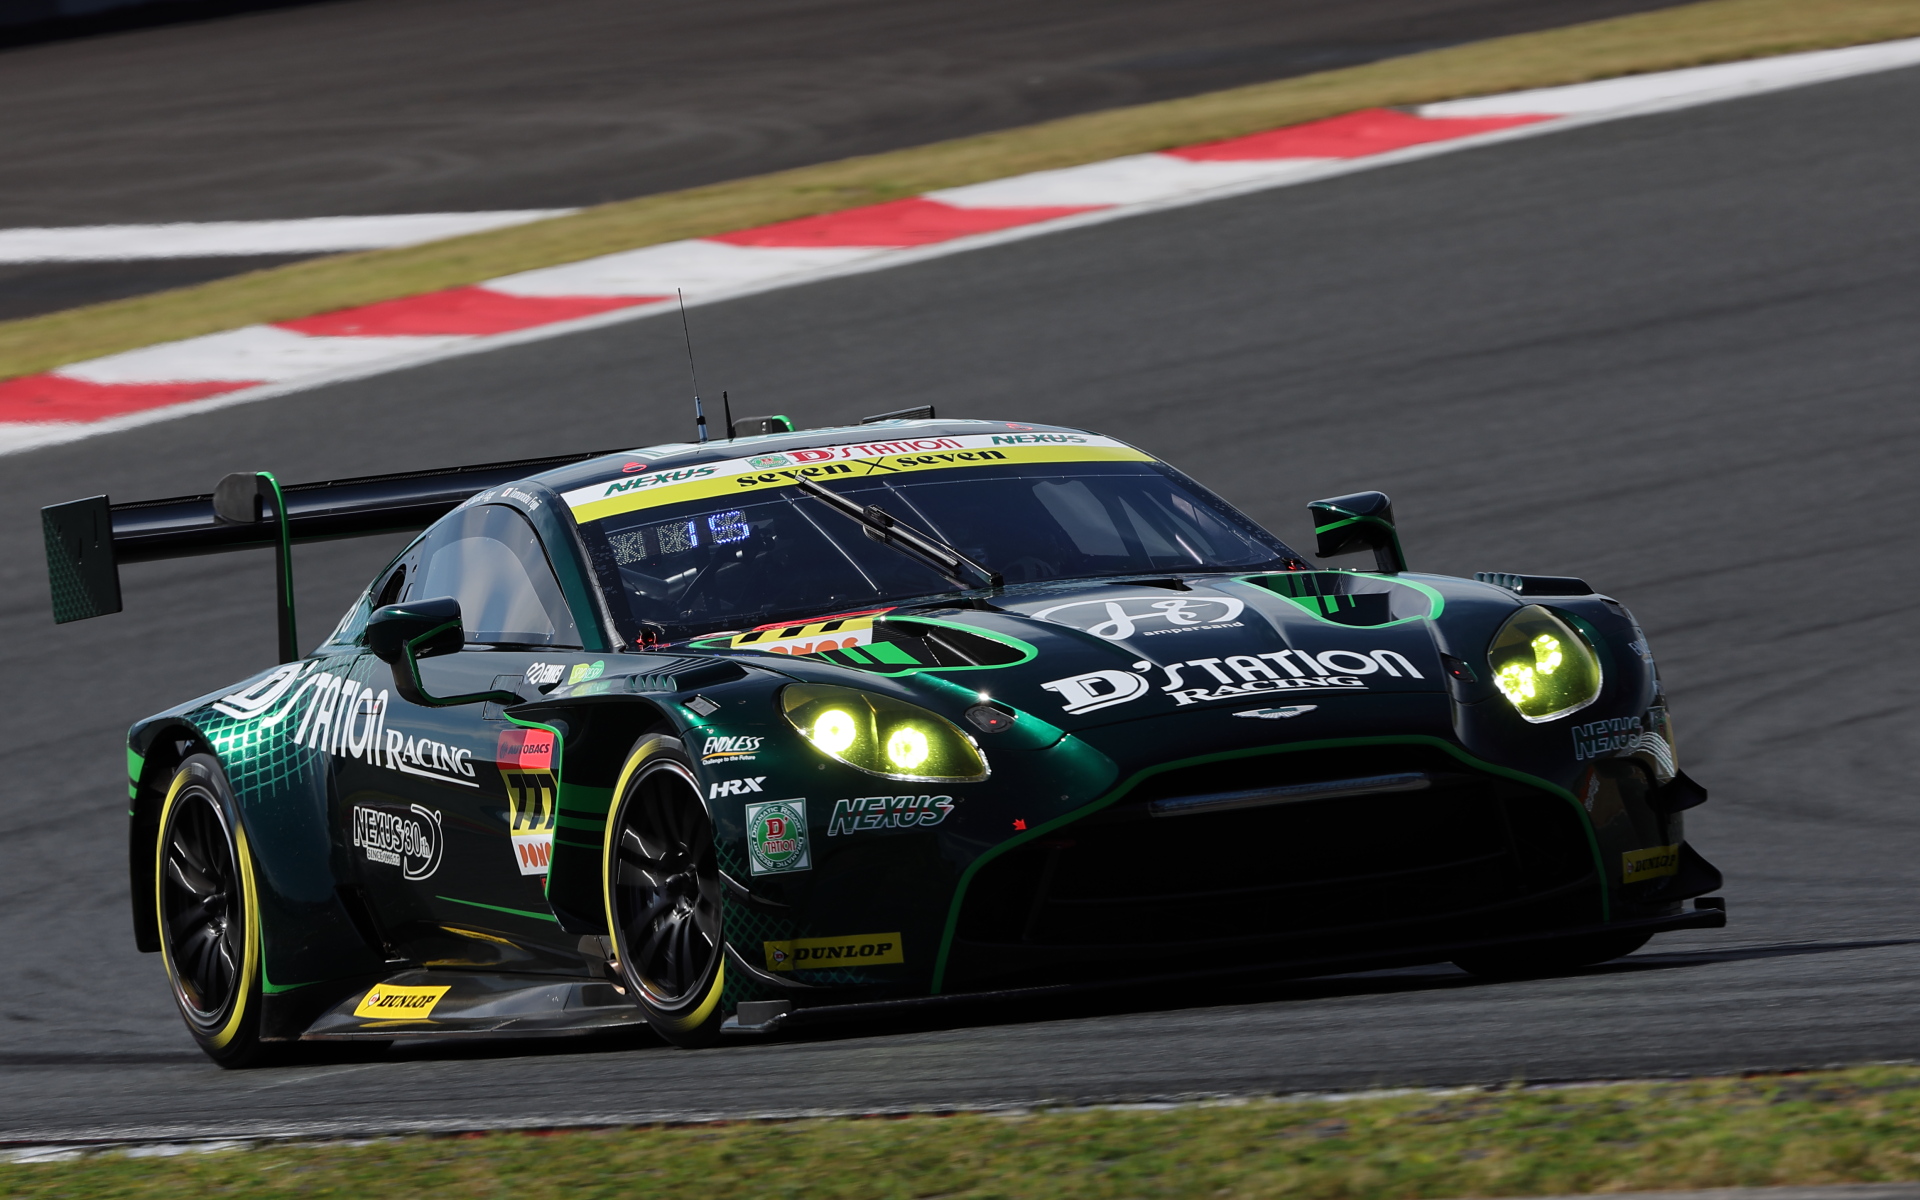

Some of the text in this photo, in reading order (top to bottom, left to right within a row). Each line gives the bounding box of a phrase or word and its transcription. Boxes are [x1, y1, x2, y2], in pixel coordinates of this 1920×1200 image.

[787, 438, 964, 463] D'STATION
[990, 434, 1088, 446] NEXUS
[603, 465, 719, 496] NEXUS
[737, 462, 852, 488] seven
[897, 448, 1007, 468] seven
[1143, 621, 1246, 637] ampersand
[1040, 649, 1425, 715] D'STATION
[1165, 676, 1366, 706] RACING
[210, 661, 389, 767] D'STATION
[507, 743, 551, 757] AUTOBACS
[702, 736, 765, 755] ENDLESS
[1571, 716, 1645, 761] NEXUS
[385, 729, 477, 777] RACING
[709, 776, 767, 800] HRX
[507, 773, 559, 831] 777
[827, 795, 955, 836] NEXUS
[353, 805, 404, 853] NEXUS
[762, 839, 796, 854] STATION
[1635, 855, 1677, 873] DUNLOP
[793, 942, 893, 961] DUNLOP
[376, 994, 437, 1008] DUNLOP
